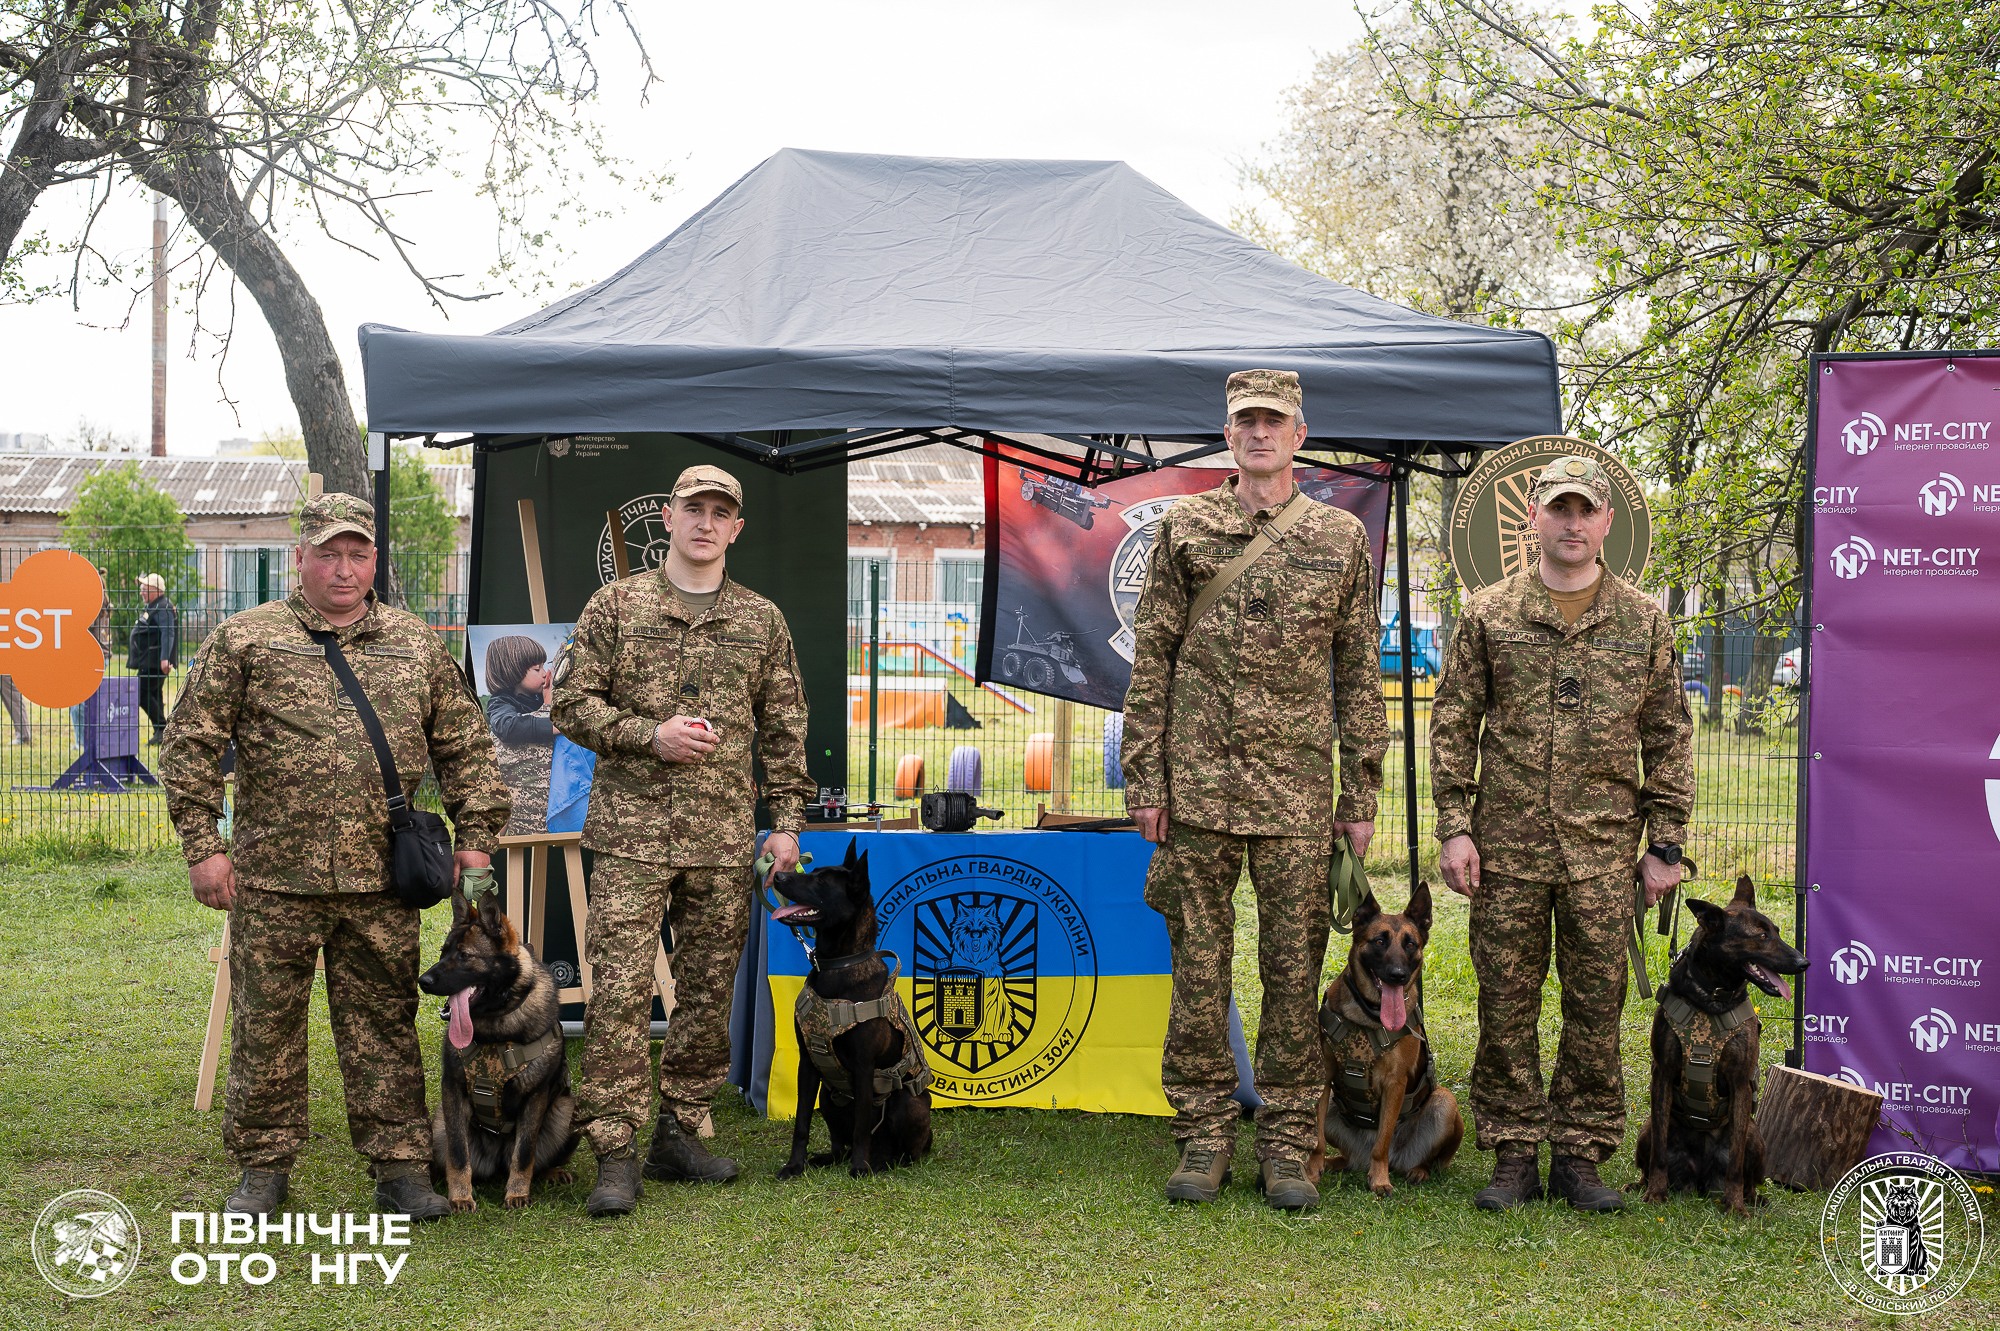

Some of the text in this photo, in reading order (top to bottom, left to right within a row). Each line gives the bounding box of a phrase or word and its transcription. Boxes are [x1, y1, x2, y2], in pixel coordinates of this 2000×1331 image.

[575, 435, 616, 443] Міністерство
[1894, 421, 1992, 441] NET-CITY
[575, 443, 629, 451] внутрішніх справ
[1894, 441, 1990, 452] інтернет провайдер
[1455, 440, 1643, 529] НАЦІОНАЛЬНА ГВАРДІЯ УКРАЇНИ
[1814, 486, 1859, 505] CITY
[1883, 547, 1981, 567] NET-CITY
[1883, 567, 1979, 577] інтернет провайдер
[968, 861, 1042, 890] ГВАРДІЯ
[1042, 885, 1089, 957] УКРАЇНИ
[1884, 954, 1983, 977] NET-CITY
[1884, 975, 1981, 988] інтернет провайдер
[1804, 1013, 1849, 1034] CITY
[1965, 1022, 2000, 1042] NET
[963, 1063, 1046, 1096] ЧАСТИНА
[1043, 1028, 1075, 1067] 3047
[1874, 1081, 1973, 1105] NET-CITY
[1916, 1105, 1971, 1116] провайдер
